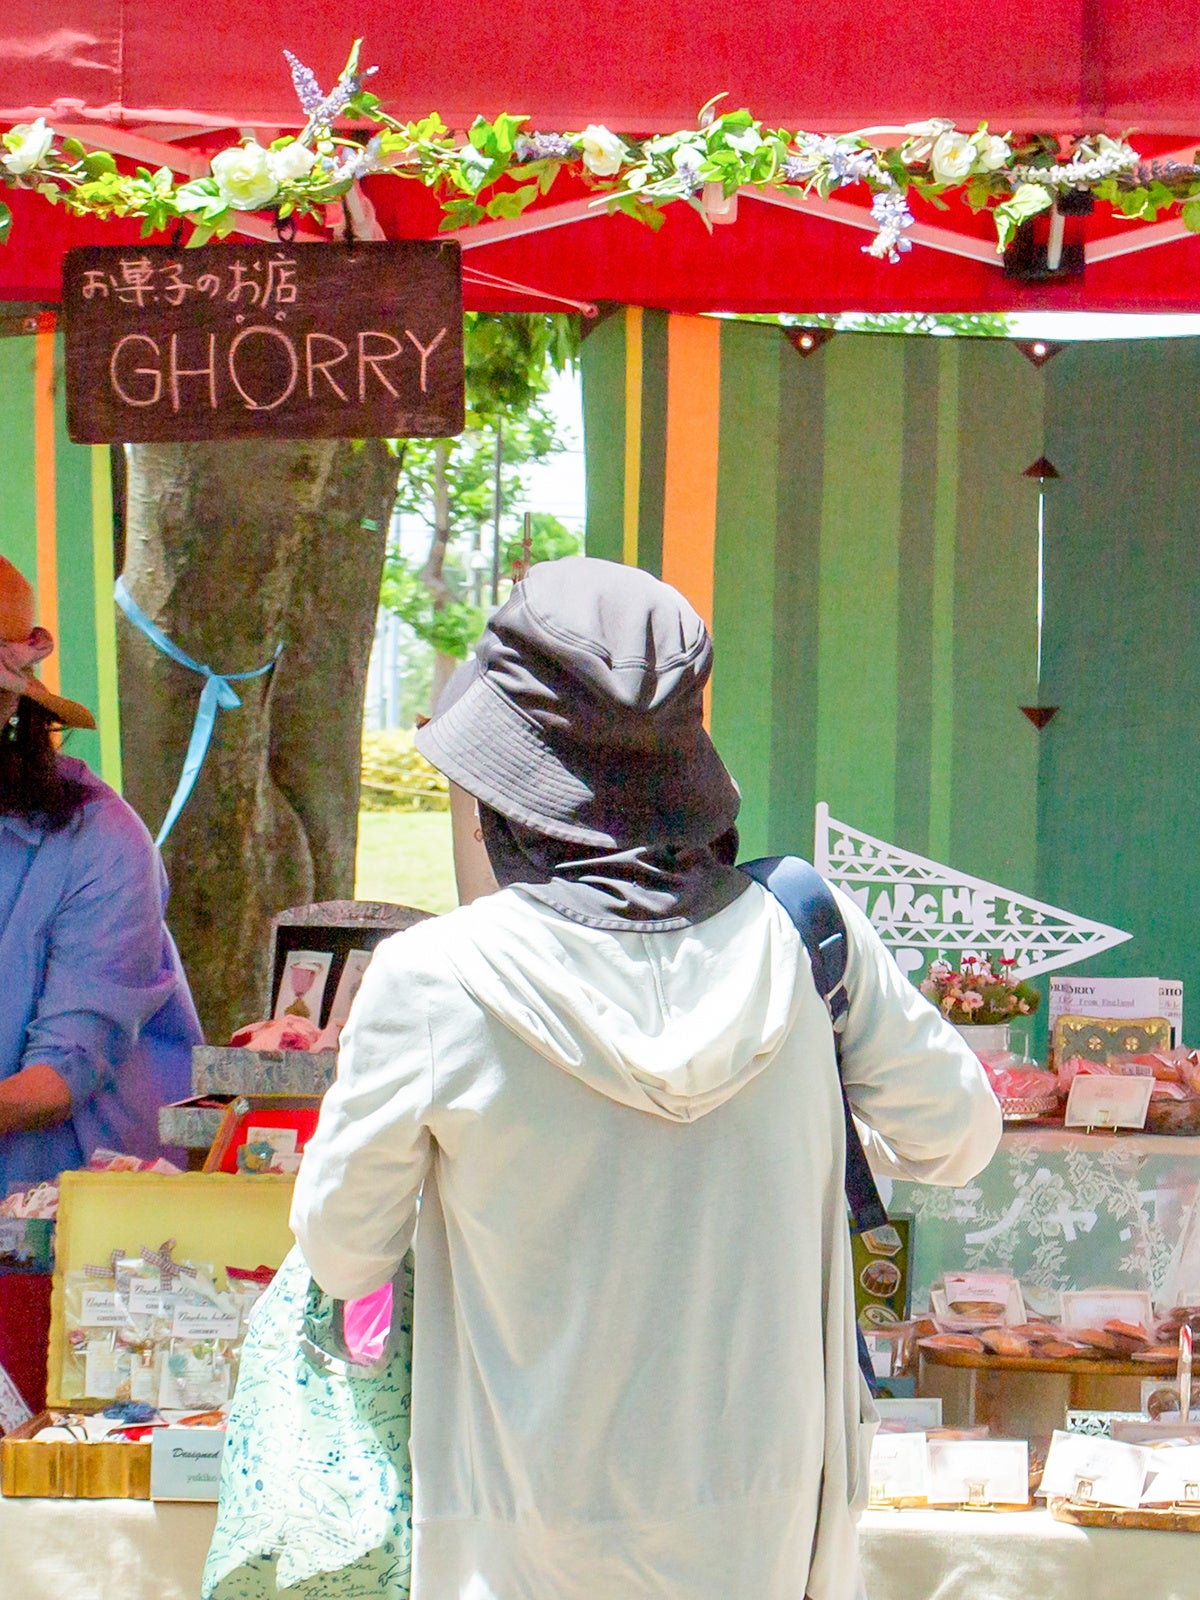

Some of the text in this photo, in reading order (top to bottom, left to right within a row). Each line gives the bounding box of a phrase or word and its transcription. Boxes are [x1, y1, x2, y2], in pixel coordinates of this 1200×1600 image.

[82, 253, 298, 308] お菓子のお店
[172, 1447, 221, 1462] Designed
